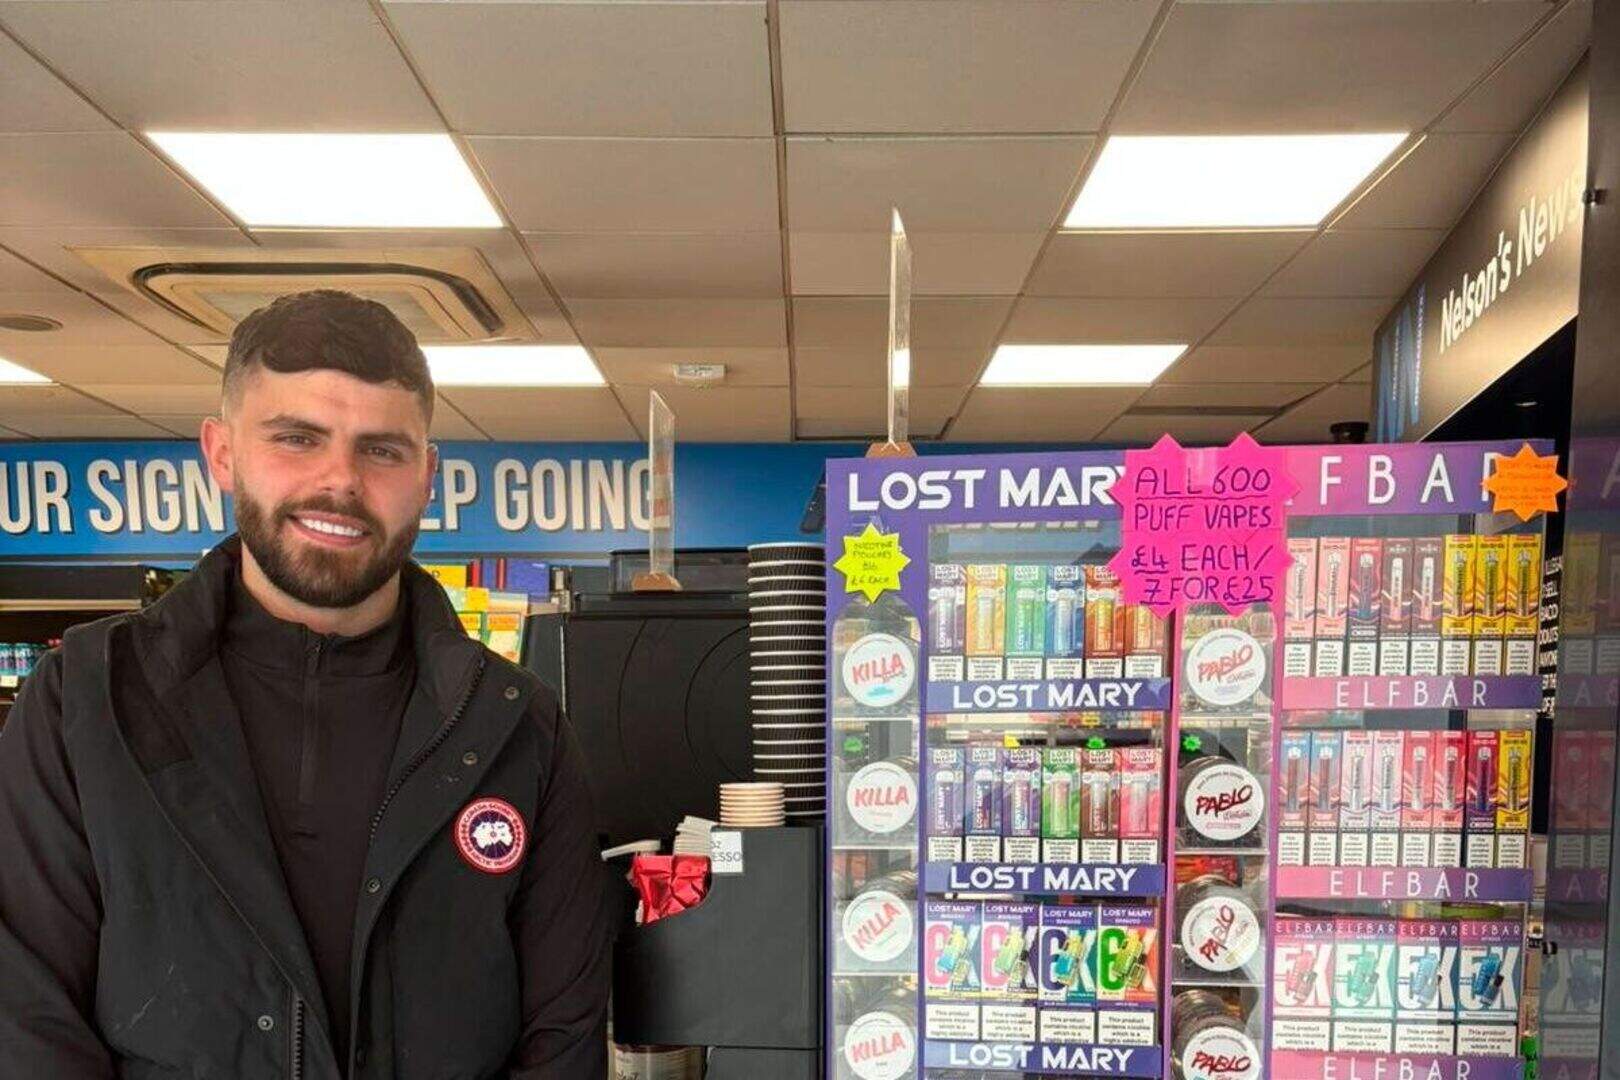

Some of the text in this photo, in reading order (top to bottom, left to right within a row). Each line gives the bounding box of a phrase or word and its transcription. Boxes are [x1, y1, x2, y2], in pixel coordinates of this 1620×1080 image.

[1440, 231, 1512, 353] Nelson's
[849, 466, 1125, 511] LOST MAR
[1134, 465, 1272, 495] ALL 600
[0, 460, 73, 533] UR
[87, 459, 225, 532] SIGN
[1134, 503, 1272, 531] PUFF VAPES
[1131, 545, 1169, 570] £4
[1144, 576, 1274, 602] 7 FOR £25
[852, 653, 905, 684] KILLA
[1197, 644, 1253, 683] PABLO
[953, 682, 1143, 709] LOST MARY
[1336, 680, 1487, 707] ELFBAR
[854, 785, 910, 807] KILLA
[1196, 785, 1253, 817] PABLO
[951, 866, 1138, 891] LOST MARY
[1330, 870, 1479, 897] ELFBAR
[852, 903, 901, 950] KILLA
[851, 1030, 906, 1064] KILLA
[950, 1043, 1135, 1072] LOST MARY
[1191, 1052, 1252, 1077] PABLO
[1323, 1056, 1470, 1080] ELFBAR
